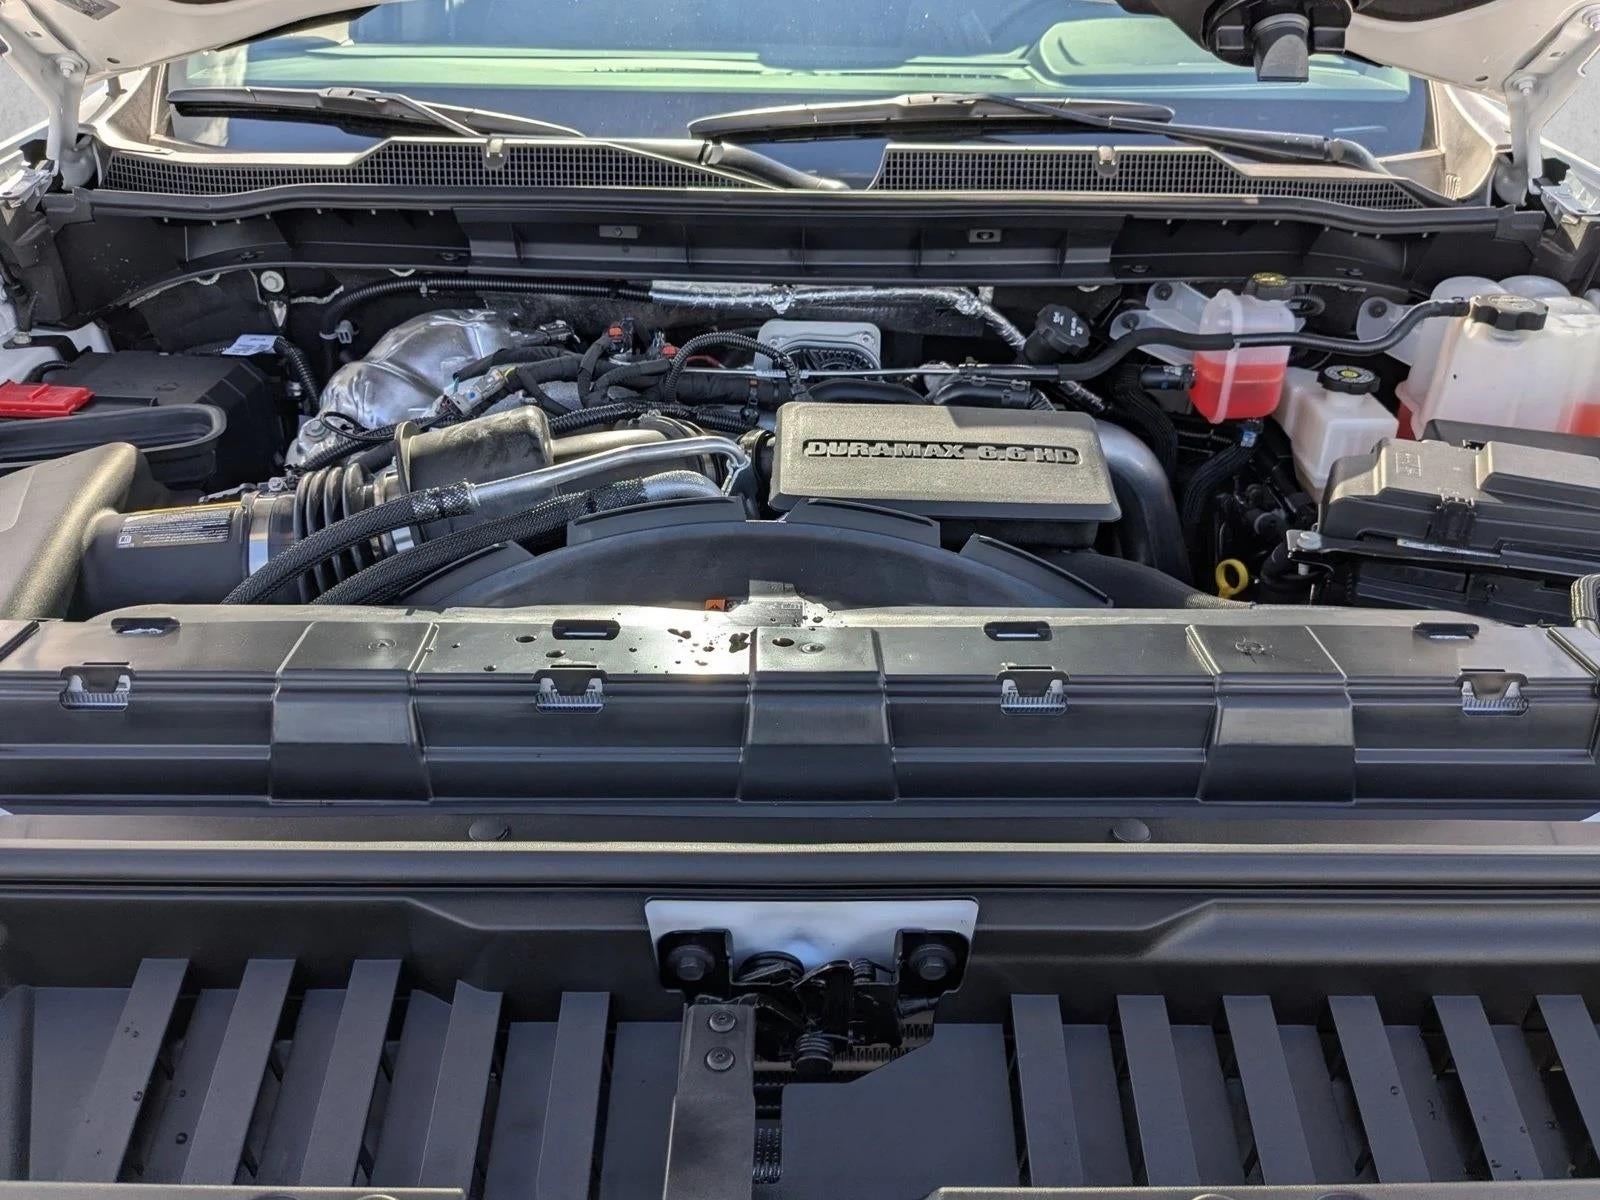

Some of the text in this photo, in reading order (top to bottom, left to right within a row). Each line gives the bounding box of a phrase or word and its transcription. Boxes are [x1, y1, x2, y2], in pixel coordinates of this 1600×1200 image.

[804, 441, 1077, 464] DURAMAX 6.6 HD
